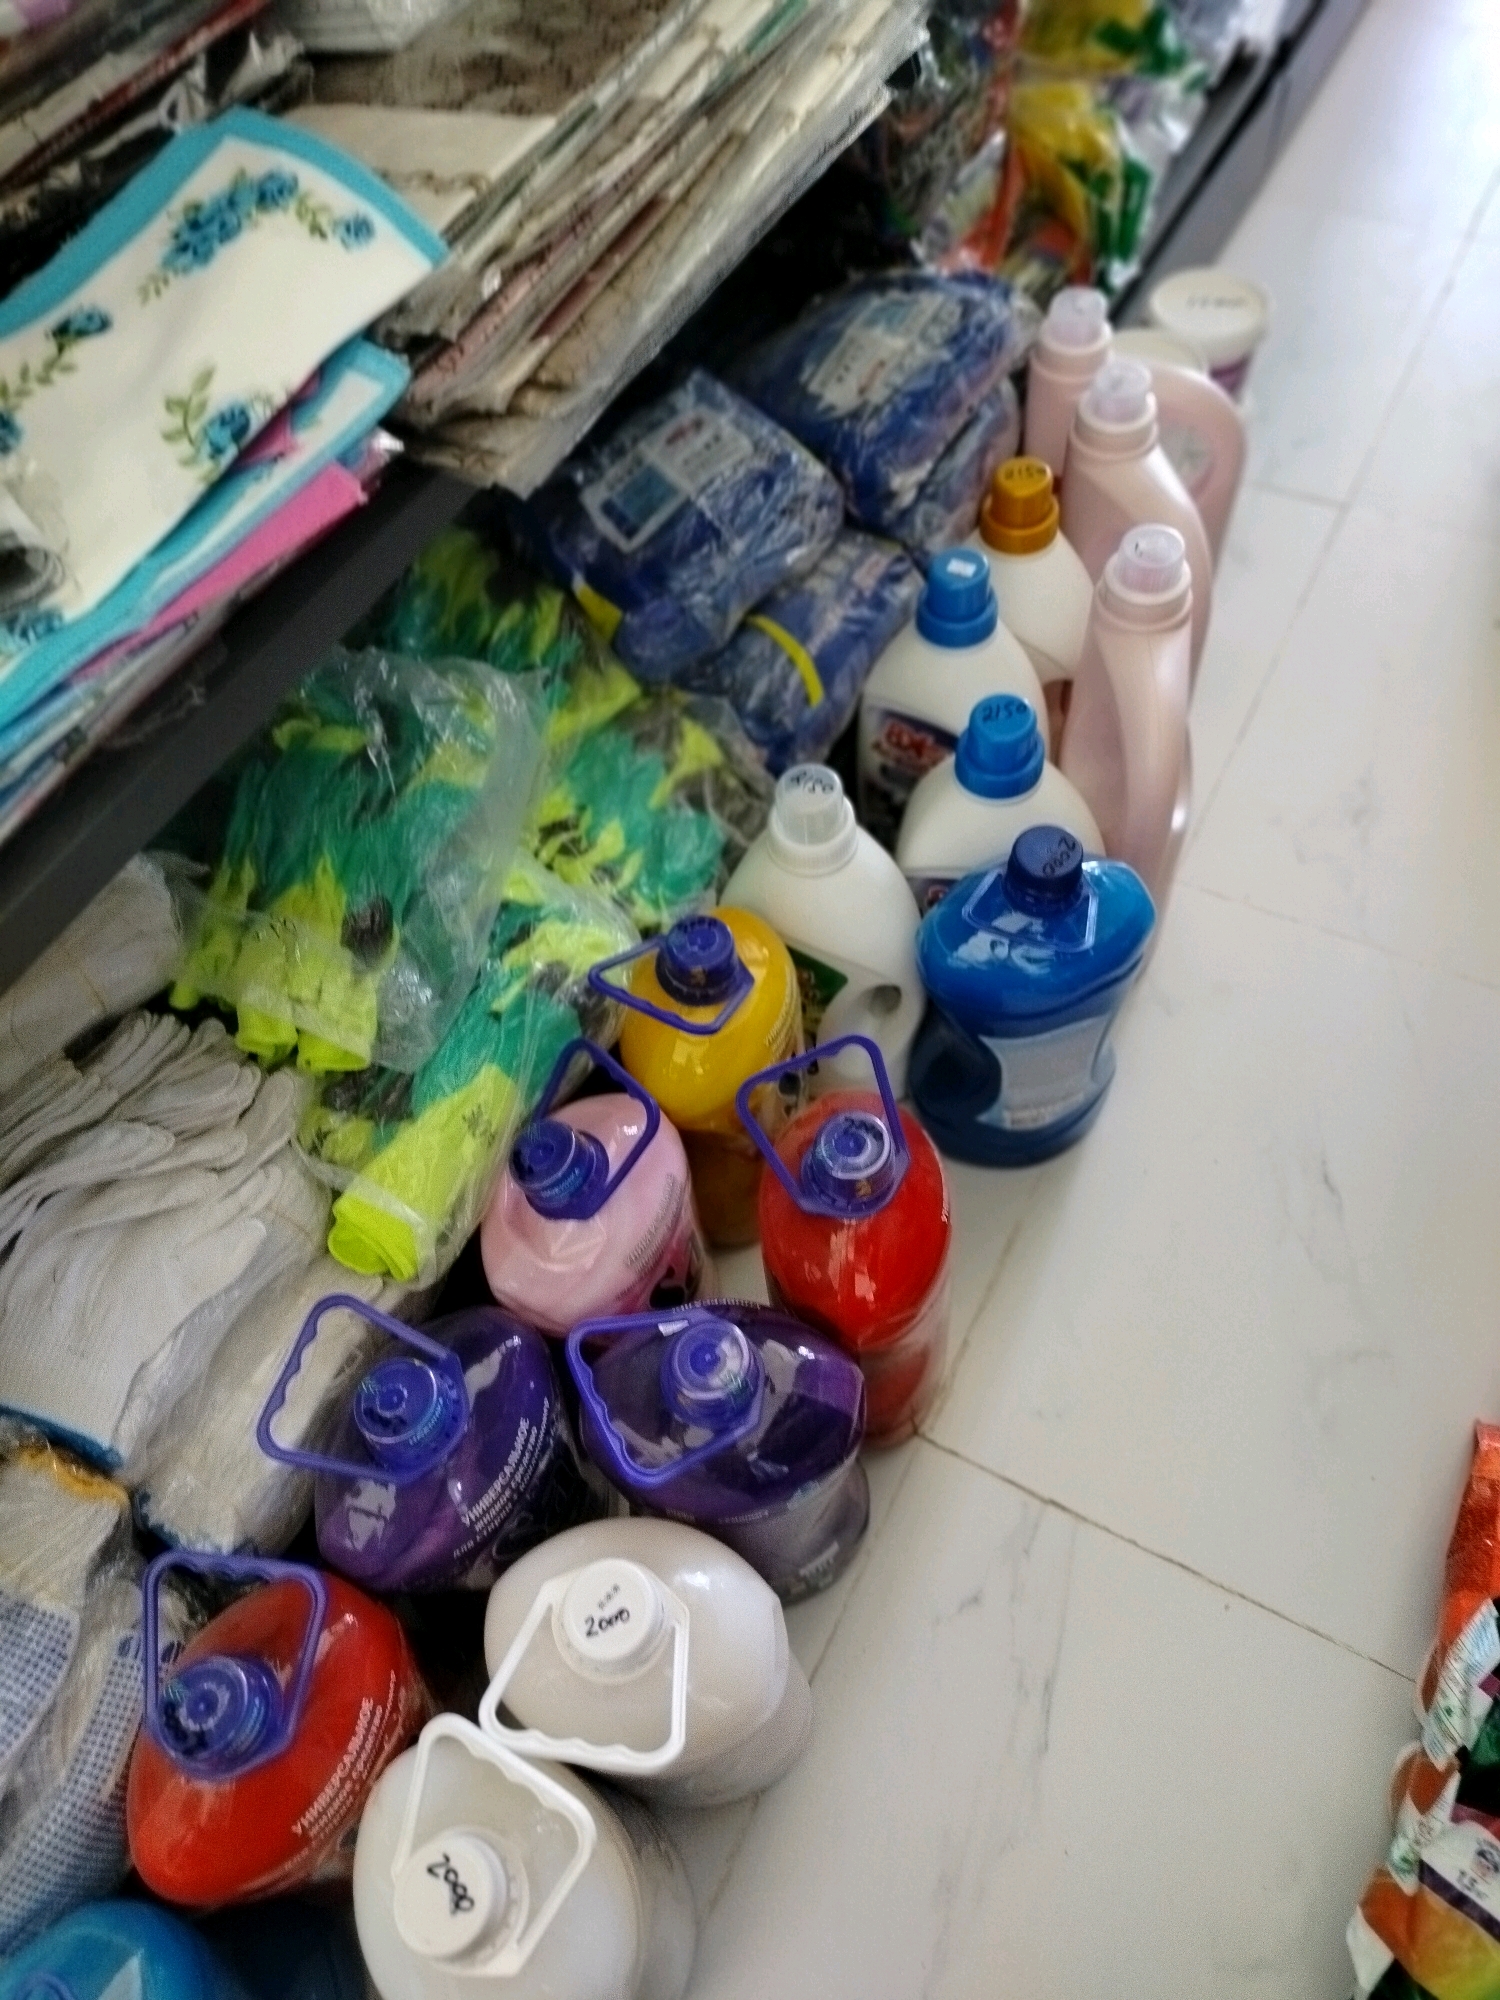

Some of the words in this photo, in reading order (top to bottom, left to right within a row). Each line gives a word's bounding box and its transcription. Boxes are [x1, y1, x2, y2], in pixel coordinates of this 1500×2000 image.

[982, 700, 1028, 723] 2150
[461, 1416, 530, 1528] УНИВЕРСАЛЬНОЕ
[291, 1697, 374, 1838] УНИВЕРСАЛЬНОЕ
